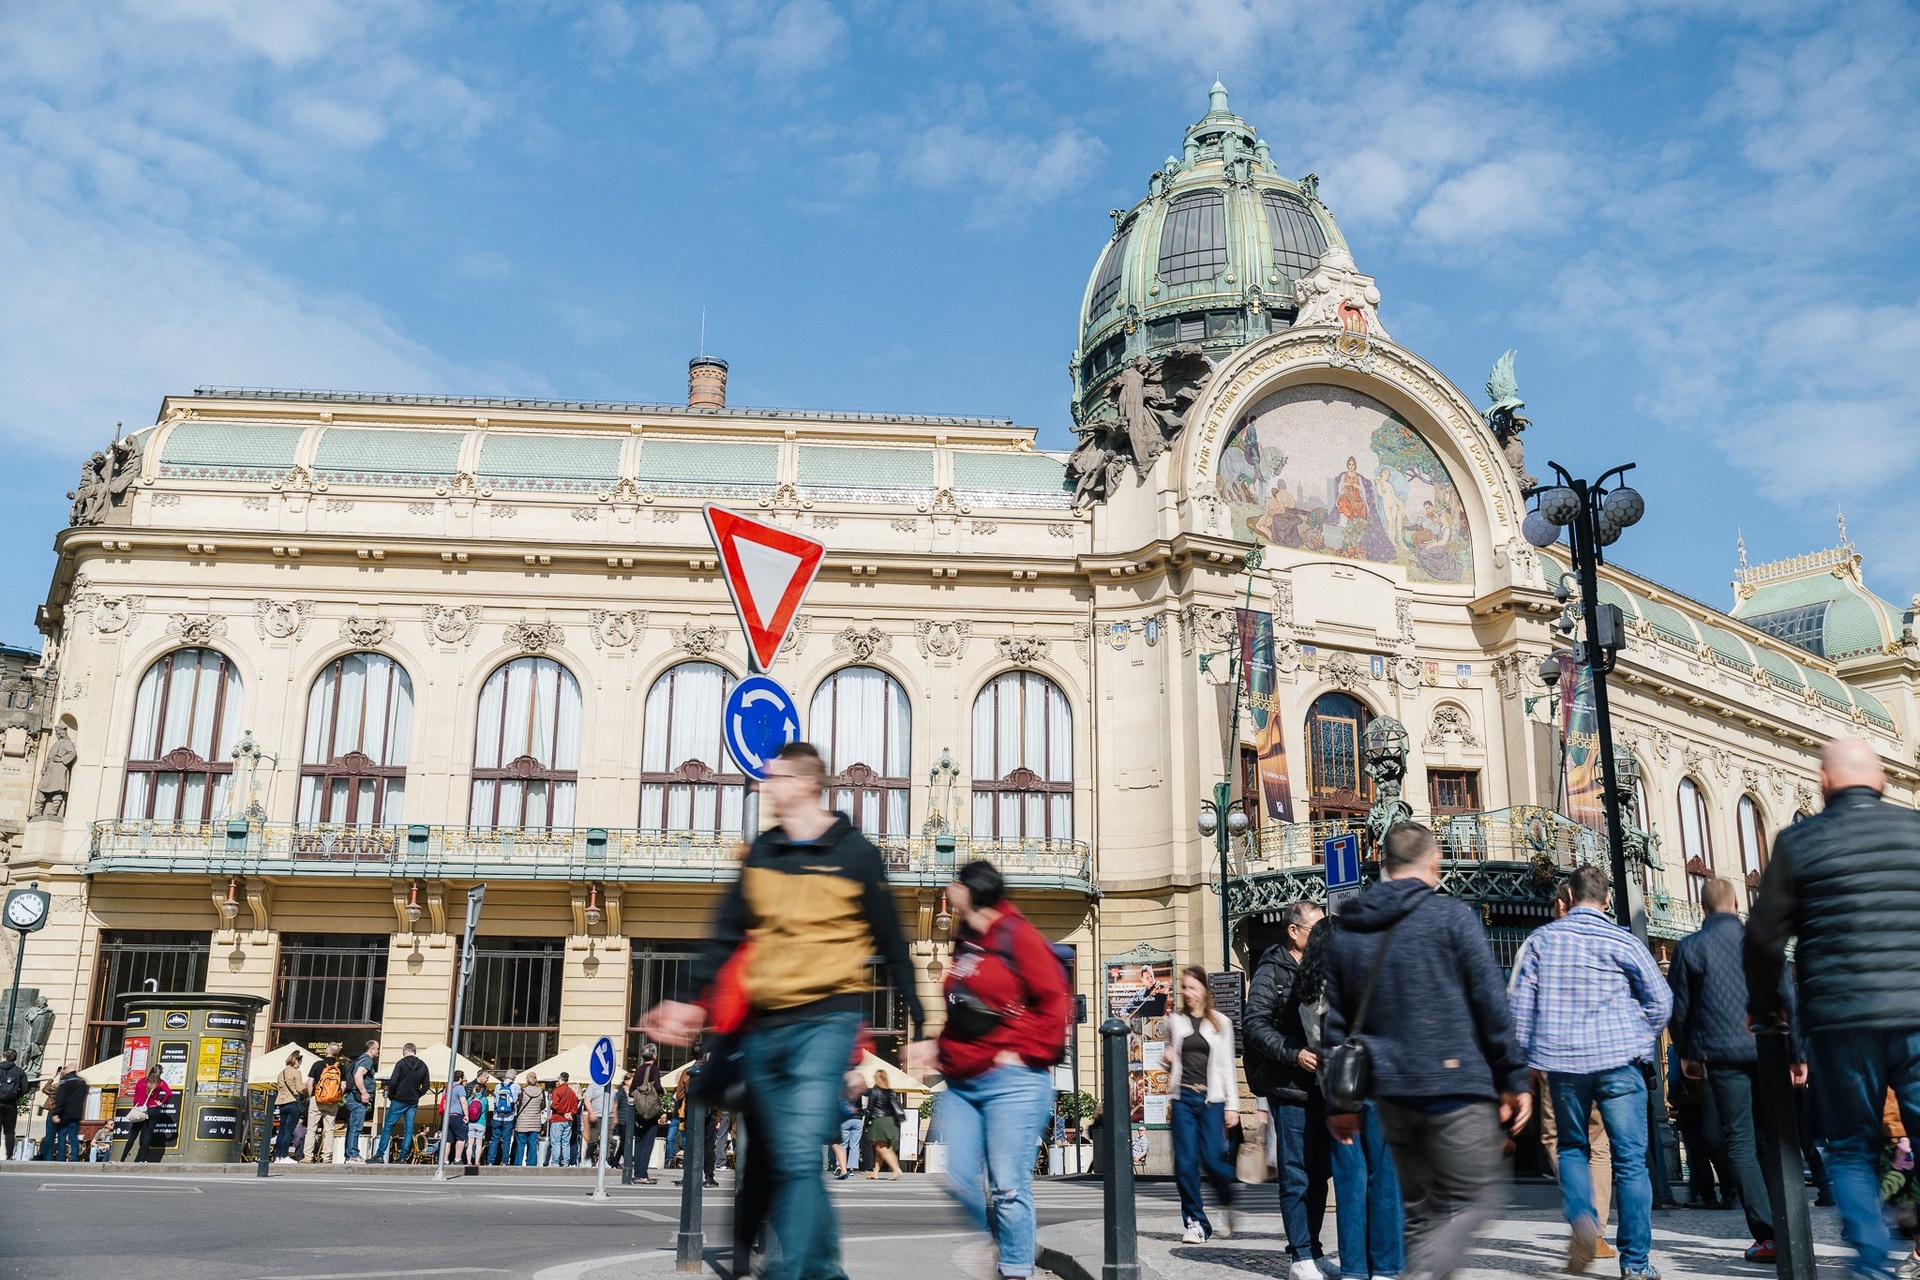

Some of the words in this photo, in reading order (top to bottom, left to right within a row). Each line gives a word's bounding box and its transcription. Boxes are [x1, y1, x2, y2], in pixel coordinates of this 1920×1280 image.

[1252, 691, 1274, 702] BELLE
[1571, 731, 1597, 742] BELLE
[1338, 891, 1350, 900] MIMO
